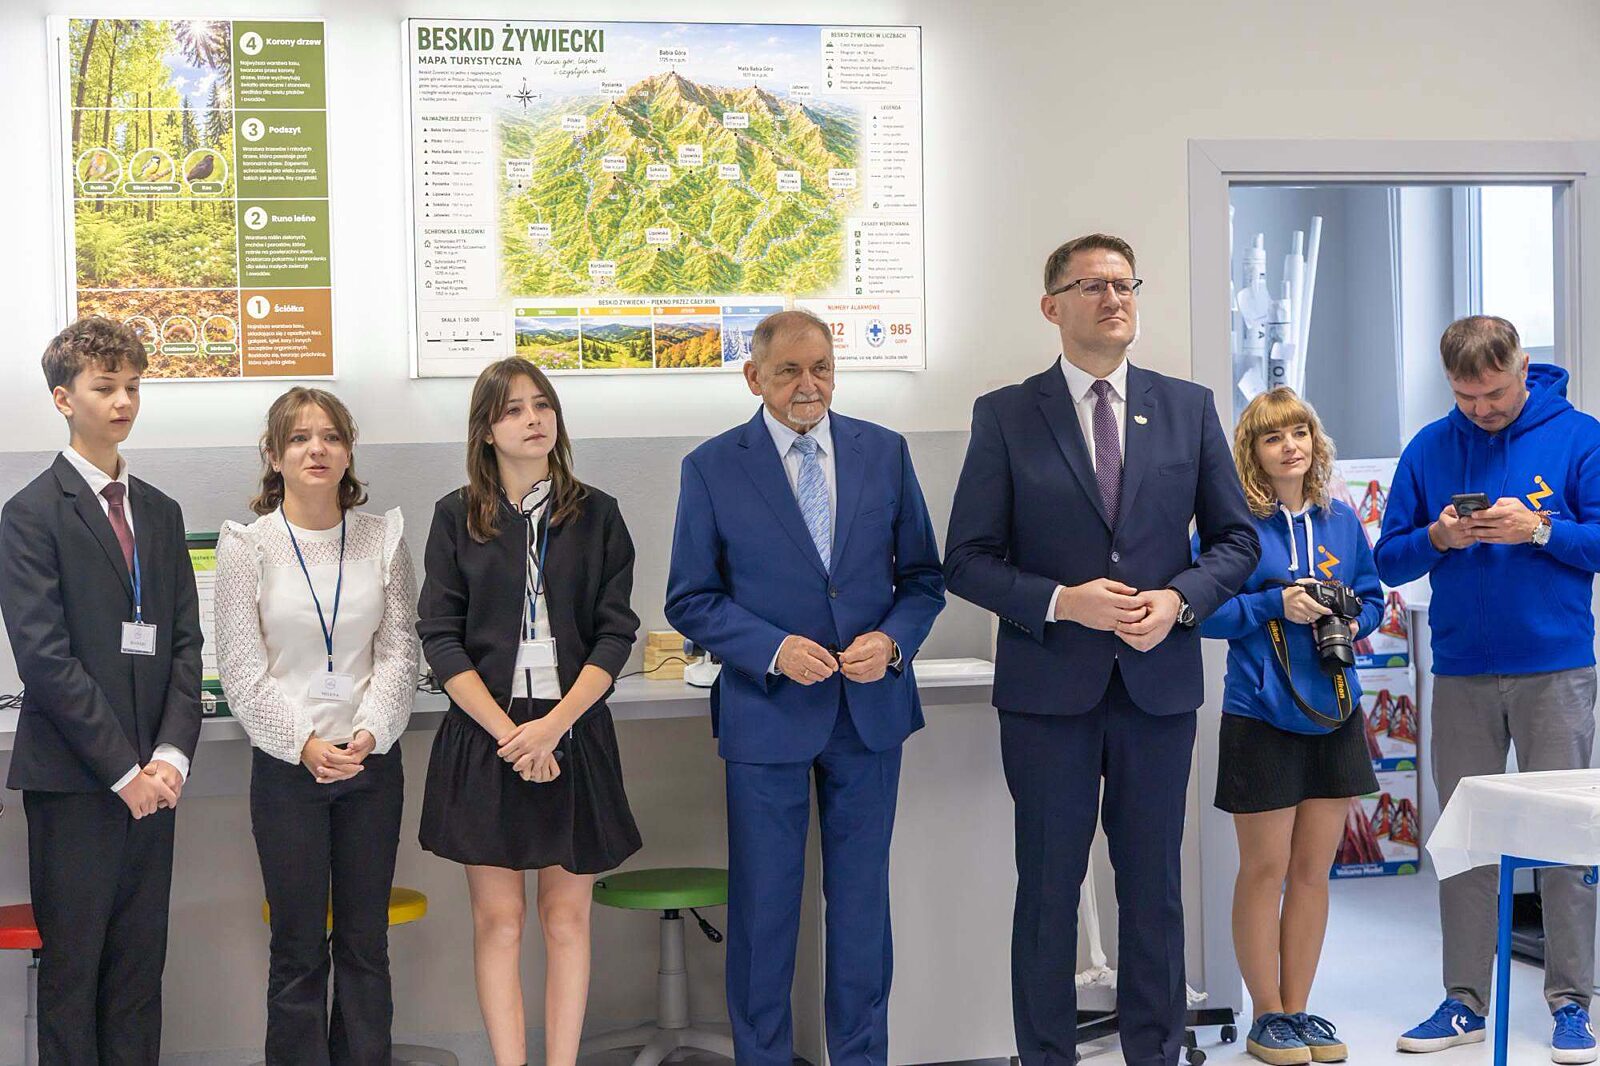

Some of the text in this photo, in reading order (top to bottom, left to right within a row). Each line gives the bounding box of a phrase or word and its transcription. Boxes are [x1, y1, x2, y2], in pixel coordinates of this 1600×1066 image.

[246, 37, 256, 50] 4
[266, 38, 321, 47] Korony drzew
[418, 24, 604, 52] BESKID ŻYWIECKI
[450, 57, 522, 65] TURYSTYCZNA
[248, 123, 258, 136] 3
[269, 127, 301, 135] Podszyt
[251, 212, 261, 225] 2
[255, 300, 261, 313] 1
[830, 323, 844, 335] 12
[890, 323, 912, 334] 985
[1336, 674, 1345, 699] Nikon
